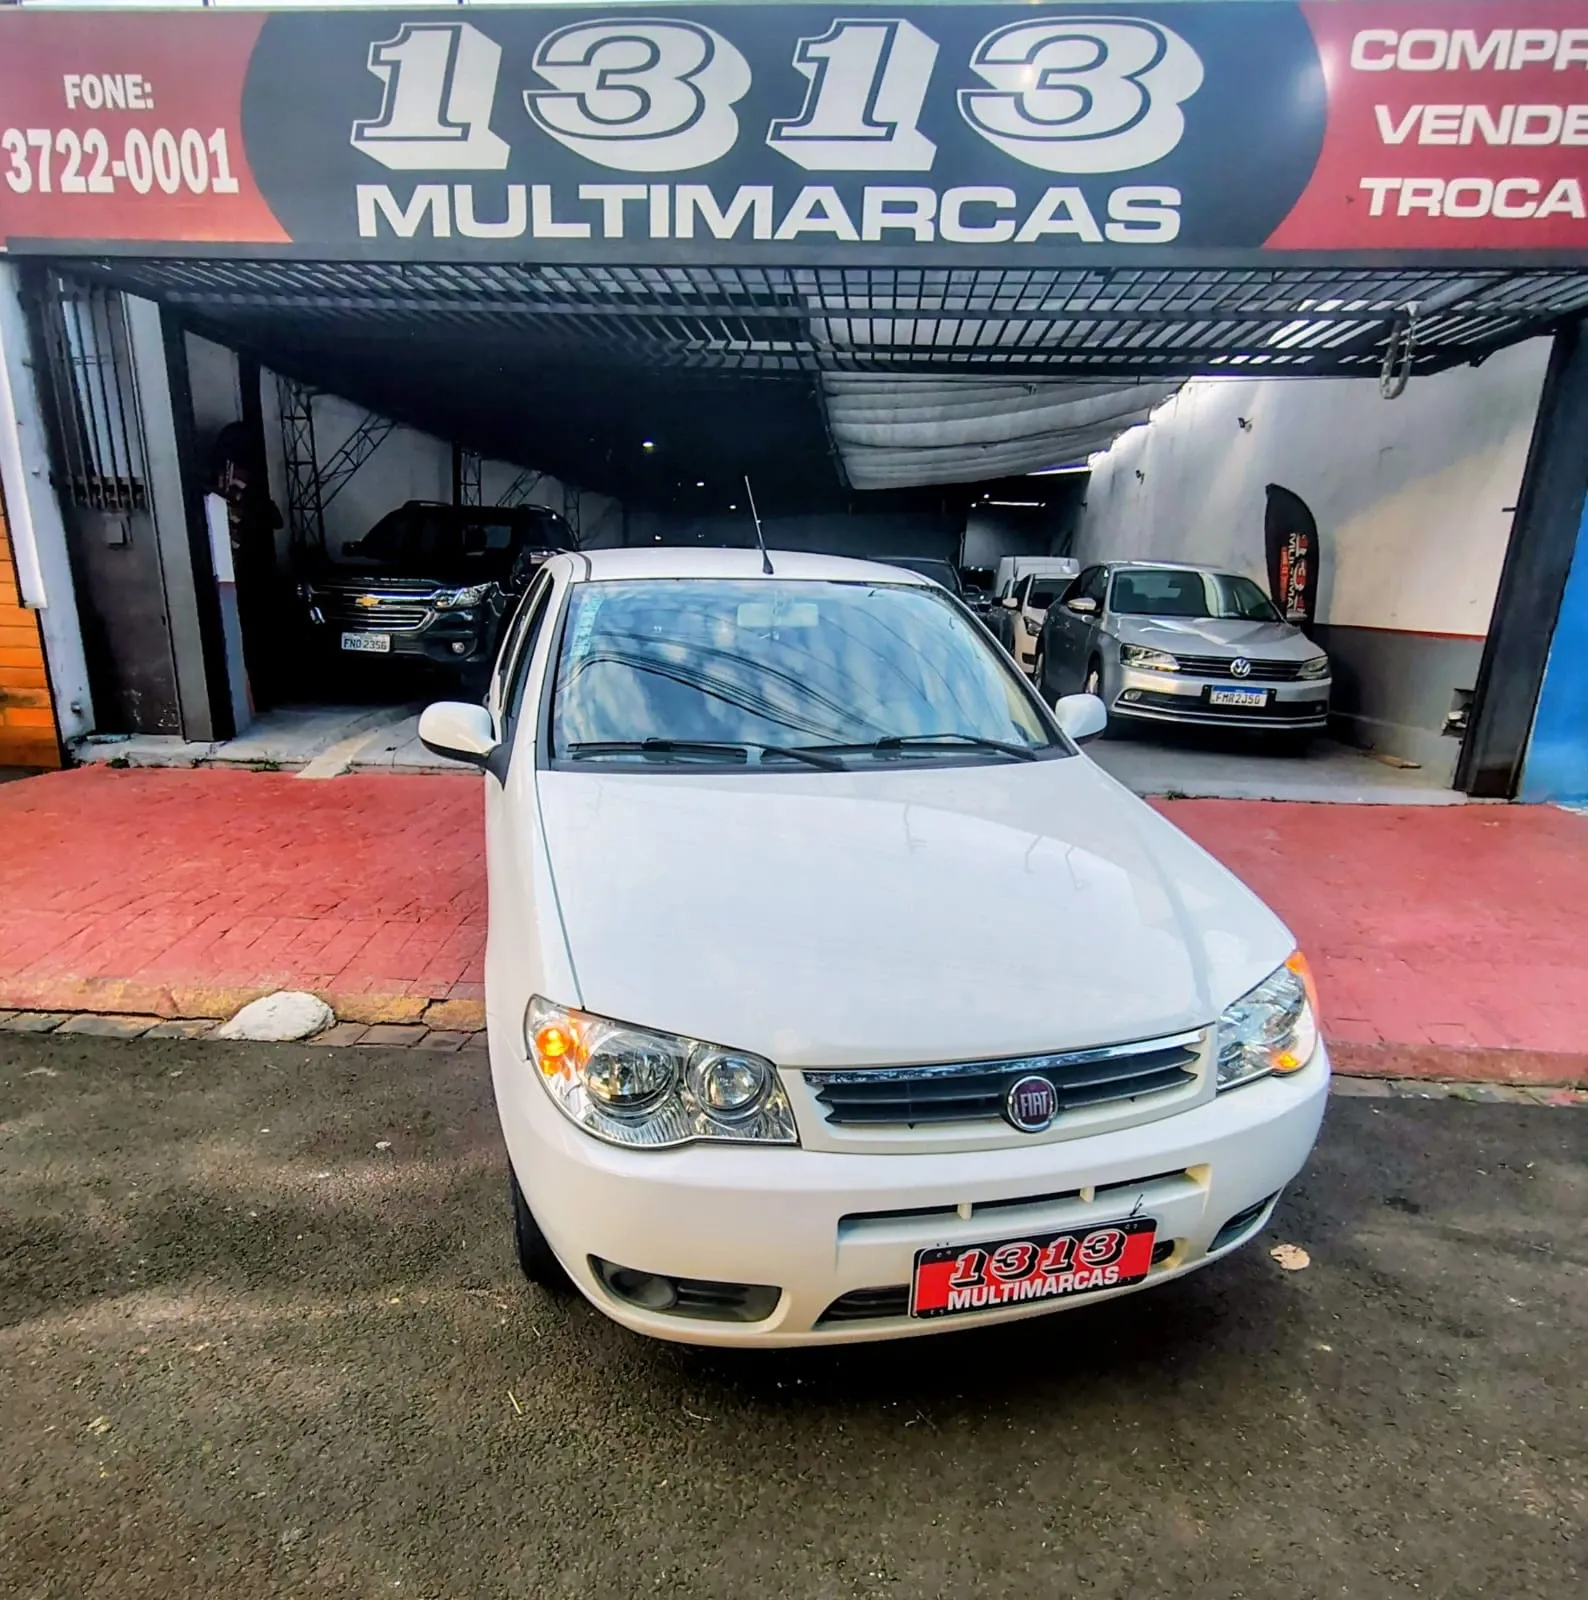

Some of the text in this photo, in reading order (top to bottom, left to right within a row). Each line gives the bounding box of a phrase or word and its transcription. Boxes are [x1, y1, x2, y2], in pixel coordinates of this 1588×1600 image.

[63, 73, 154, 109] FONE:
[350, 16, 1204, 174] 1313
[2, 127, 239, 194] 3722-0001
[356, 183, 1182, 243] MULTIMARCAS
[1359, 177, 1587, 218] TROCA
[1020, 1091, 1048, 1117] FIAT
[949, 1228, 1128, 1289] 1313
[947, 1265, 1119, 1310] MULTIMARCAS
